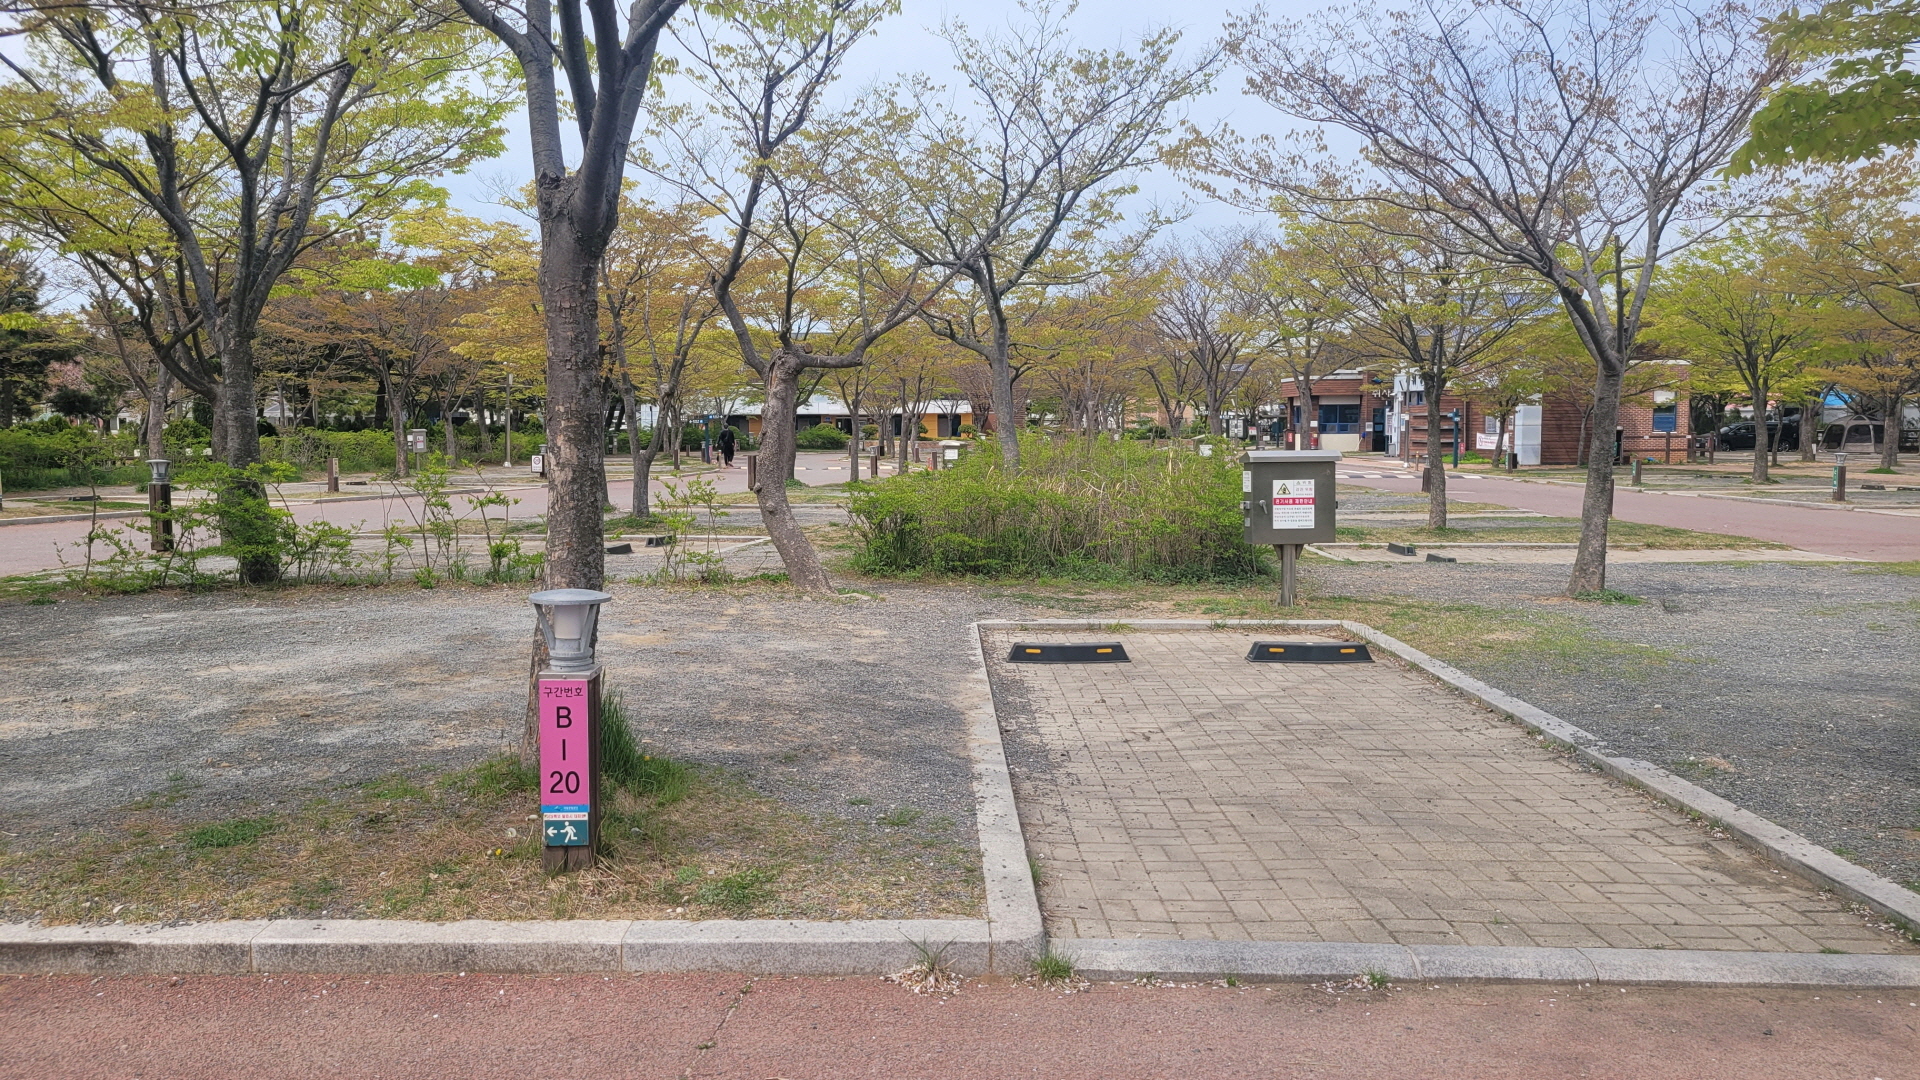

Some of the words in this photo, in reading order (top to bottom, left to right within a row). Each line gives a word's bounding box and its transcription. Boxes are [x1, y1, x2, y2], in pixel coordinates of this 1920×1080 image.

[543, 686, 584, 698] 구간번호
[556, 705, 573, 729] B
[549, 770, 580, 794] 20
